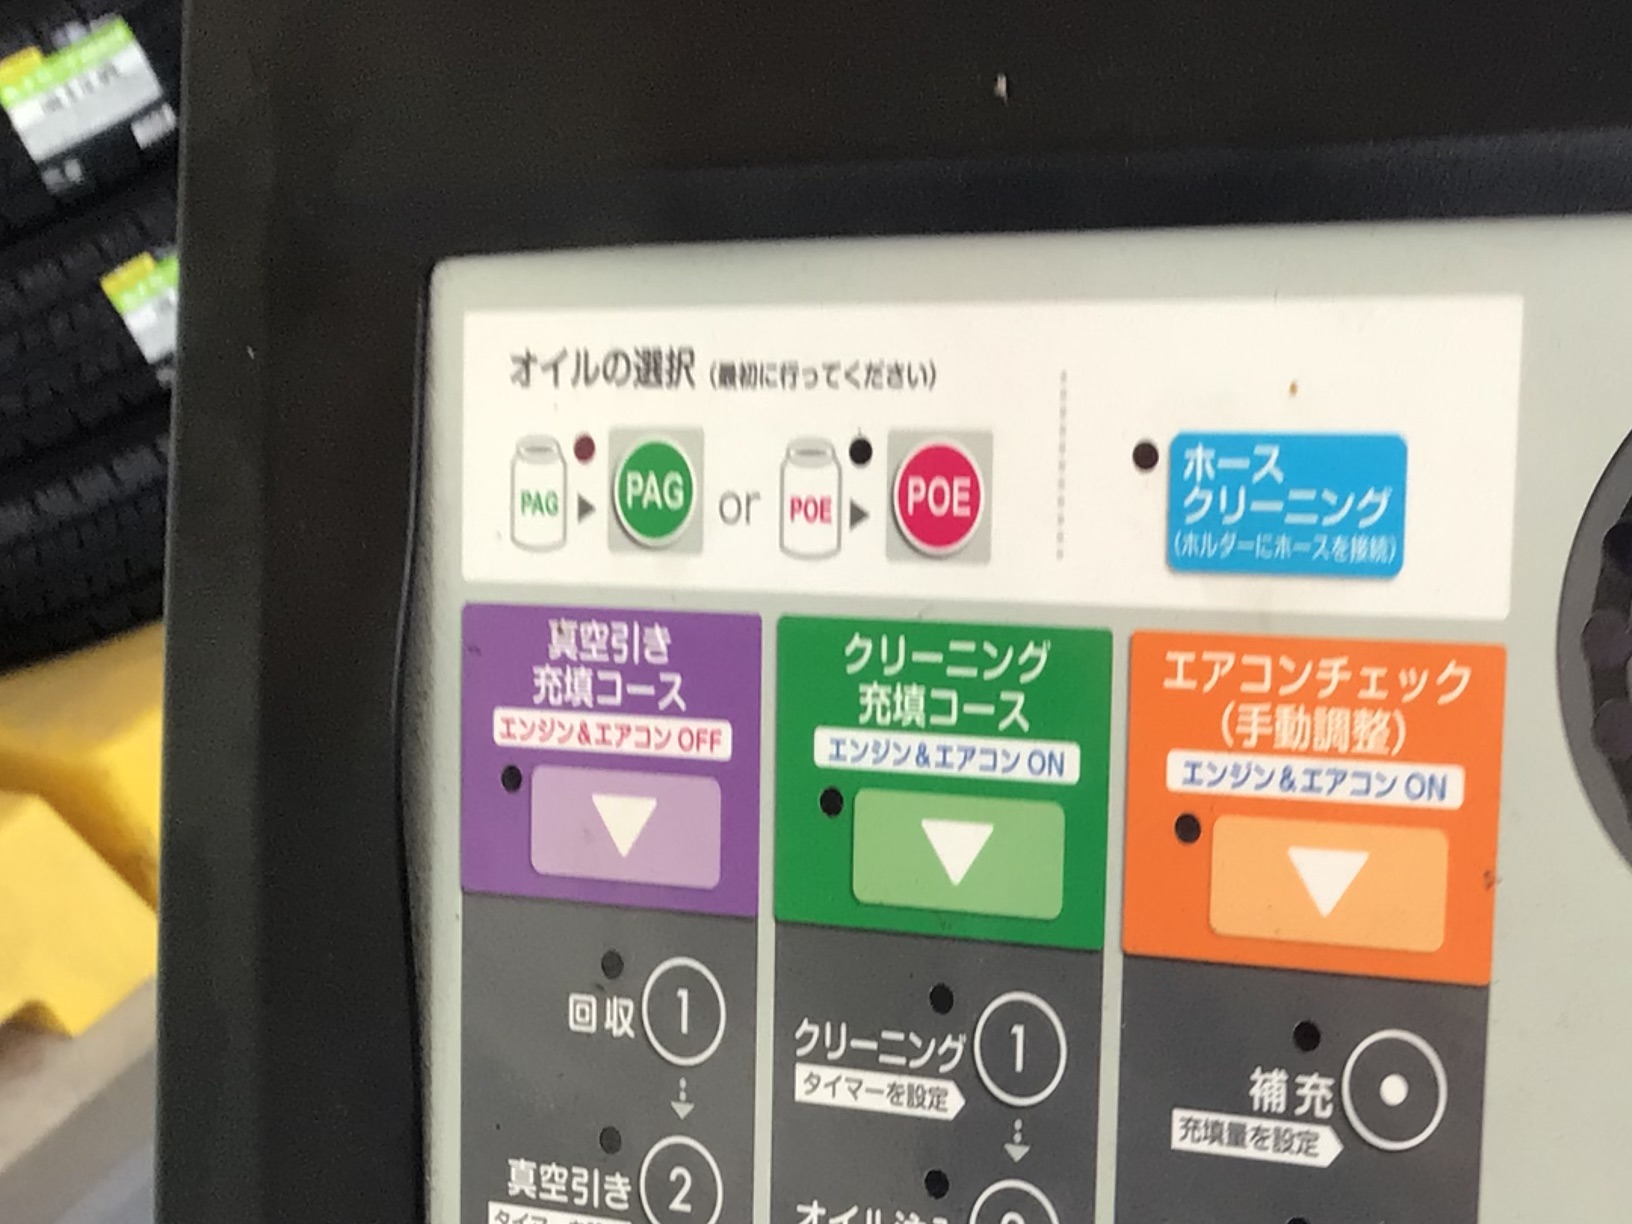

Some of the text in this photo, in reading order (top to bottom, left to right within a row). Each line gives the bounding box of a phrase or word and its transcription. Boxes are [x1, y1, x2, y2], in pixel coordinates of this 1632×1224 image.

[510, 346, 696, 390] オイルの選択
[1183, 442, 1284, 484] ホース
[520, 490, 559, 517] PAG
[626, 471, 684, 512] PAG
[718, 490, 761, 525] or
[789, 496, 832, 524] POE
[907, 475, 971, 518] POE
[1183, 485, 1393, 529] クリーニング
[548, 618, 671, 664] 真空引き
[845, 632, 1051, 683] クリーニング
[532, 664, 687, 713] 充填コース
[1163, 650, 1472, 706] エアコンチェック
[858, 682, 1030, 733] 充填コース
[679, 728, 722, 754] OFF
[1028, 752, 1064, 778] ON
[1404, 772, 1447, 802] ON
[568, 992, 635, 1039] 回収
[676, 988, 689, 1035] 1
[795, 1018, 967, 1074] クリーニング
[1010, 1023, 1025, 1073] 1
[803, 1073, 949, 1113] タイマーを設定
[1248, 1066, 1336, 1119] 補充
[1178, 1115, 1321, 1159] 充填量を設定
[507, 1158, 632, 1211] 真空引き
[668, 1166, 692, 1213] 2
